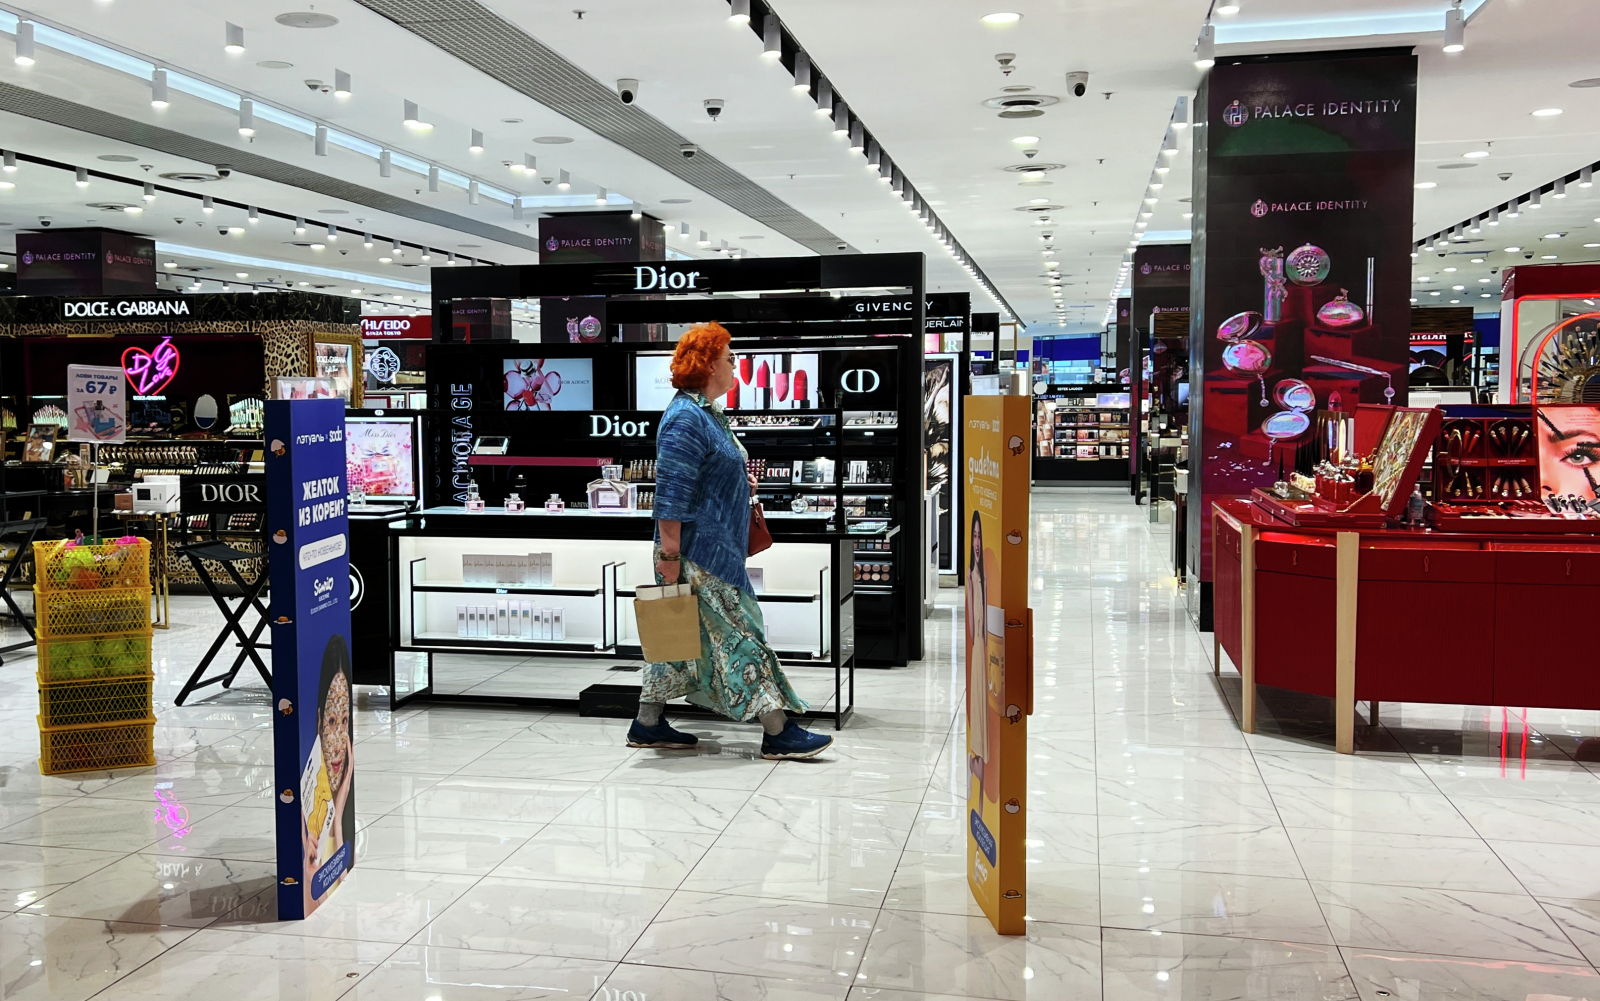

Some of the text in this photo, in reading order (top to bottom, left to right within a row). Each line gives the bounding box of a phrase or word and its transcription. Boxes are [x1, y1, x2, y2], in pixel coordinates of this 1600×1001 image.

[1254, 99, 1401, 119] PALACE IDENTITY
[1271, 200, 1368, 212] PALACE IDENTITY
[561, 237, 632, 247] PALACE IDENTITY
[35, 252, 96, 261] PALACE IDENTITY
[1154, 264, 1180, 272] PALACE
[633, 266, 700, 290] Dior
[855, 301, 934, 312] GIVENCY
[85, 381, 108, 394] 67
[359, 429, 397, 438] Miss Dior
[589, 415, 650, 437] Dior
[968, 445, 1000, 485] gudetama
[201, 484, 262, 503] DIOR
[302, 476, 340, 501] ЖЕЛТОК
[298, 498, 345, 527] ИЗ КОРЕИ?
